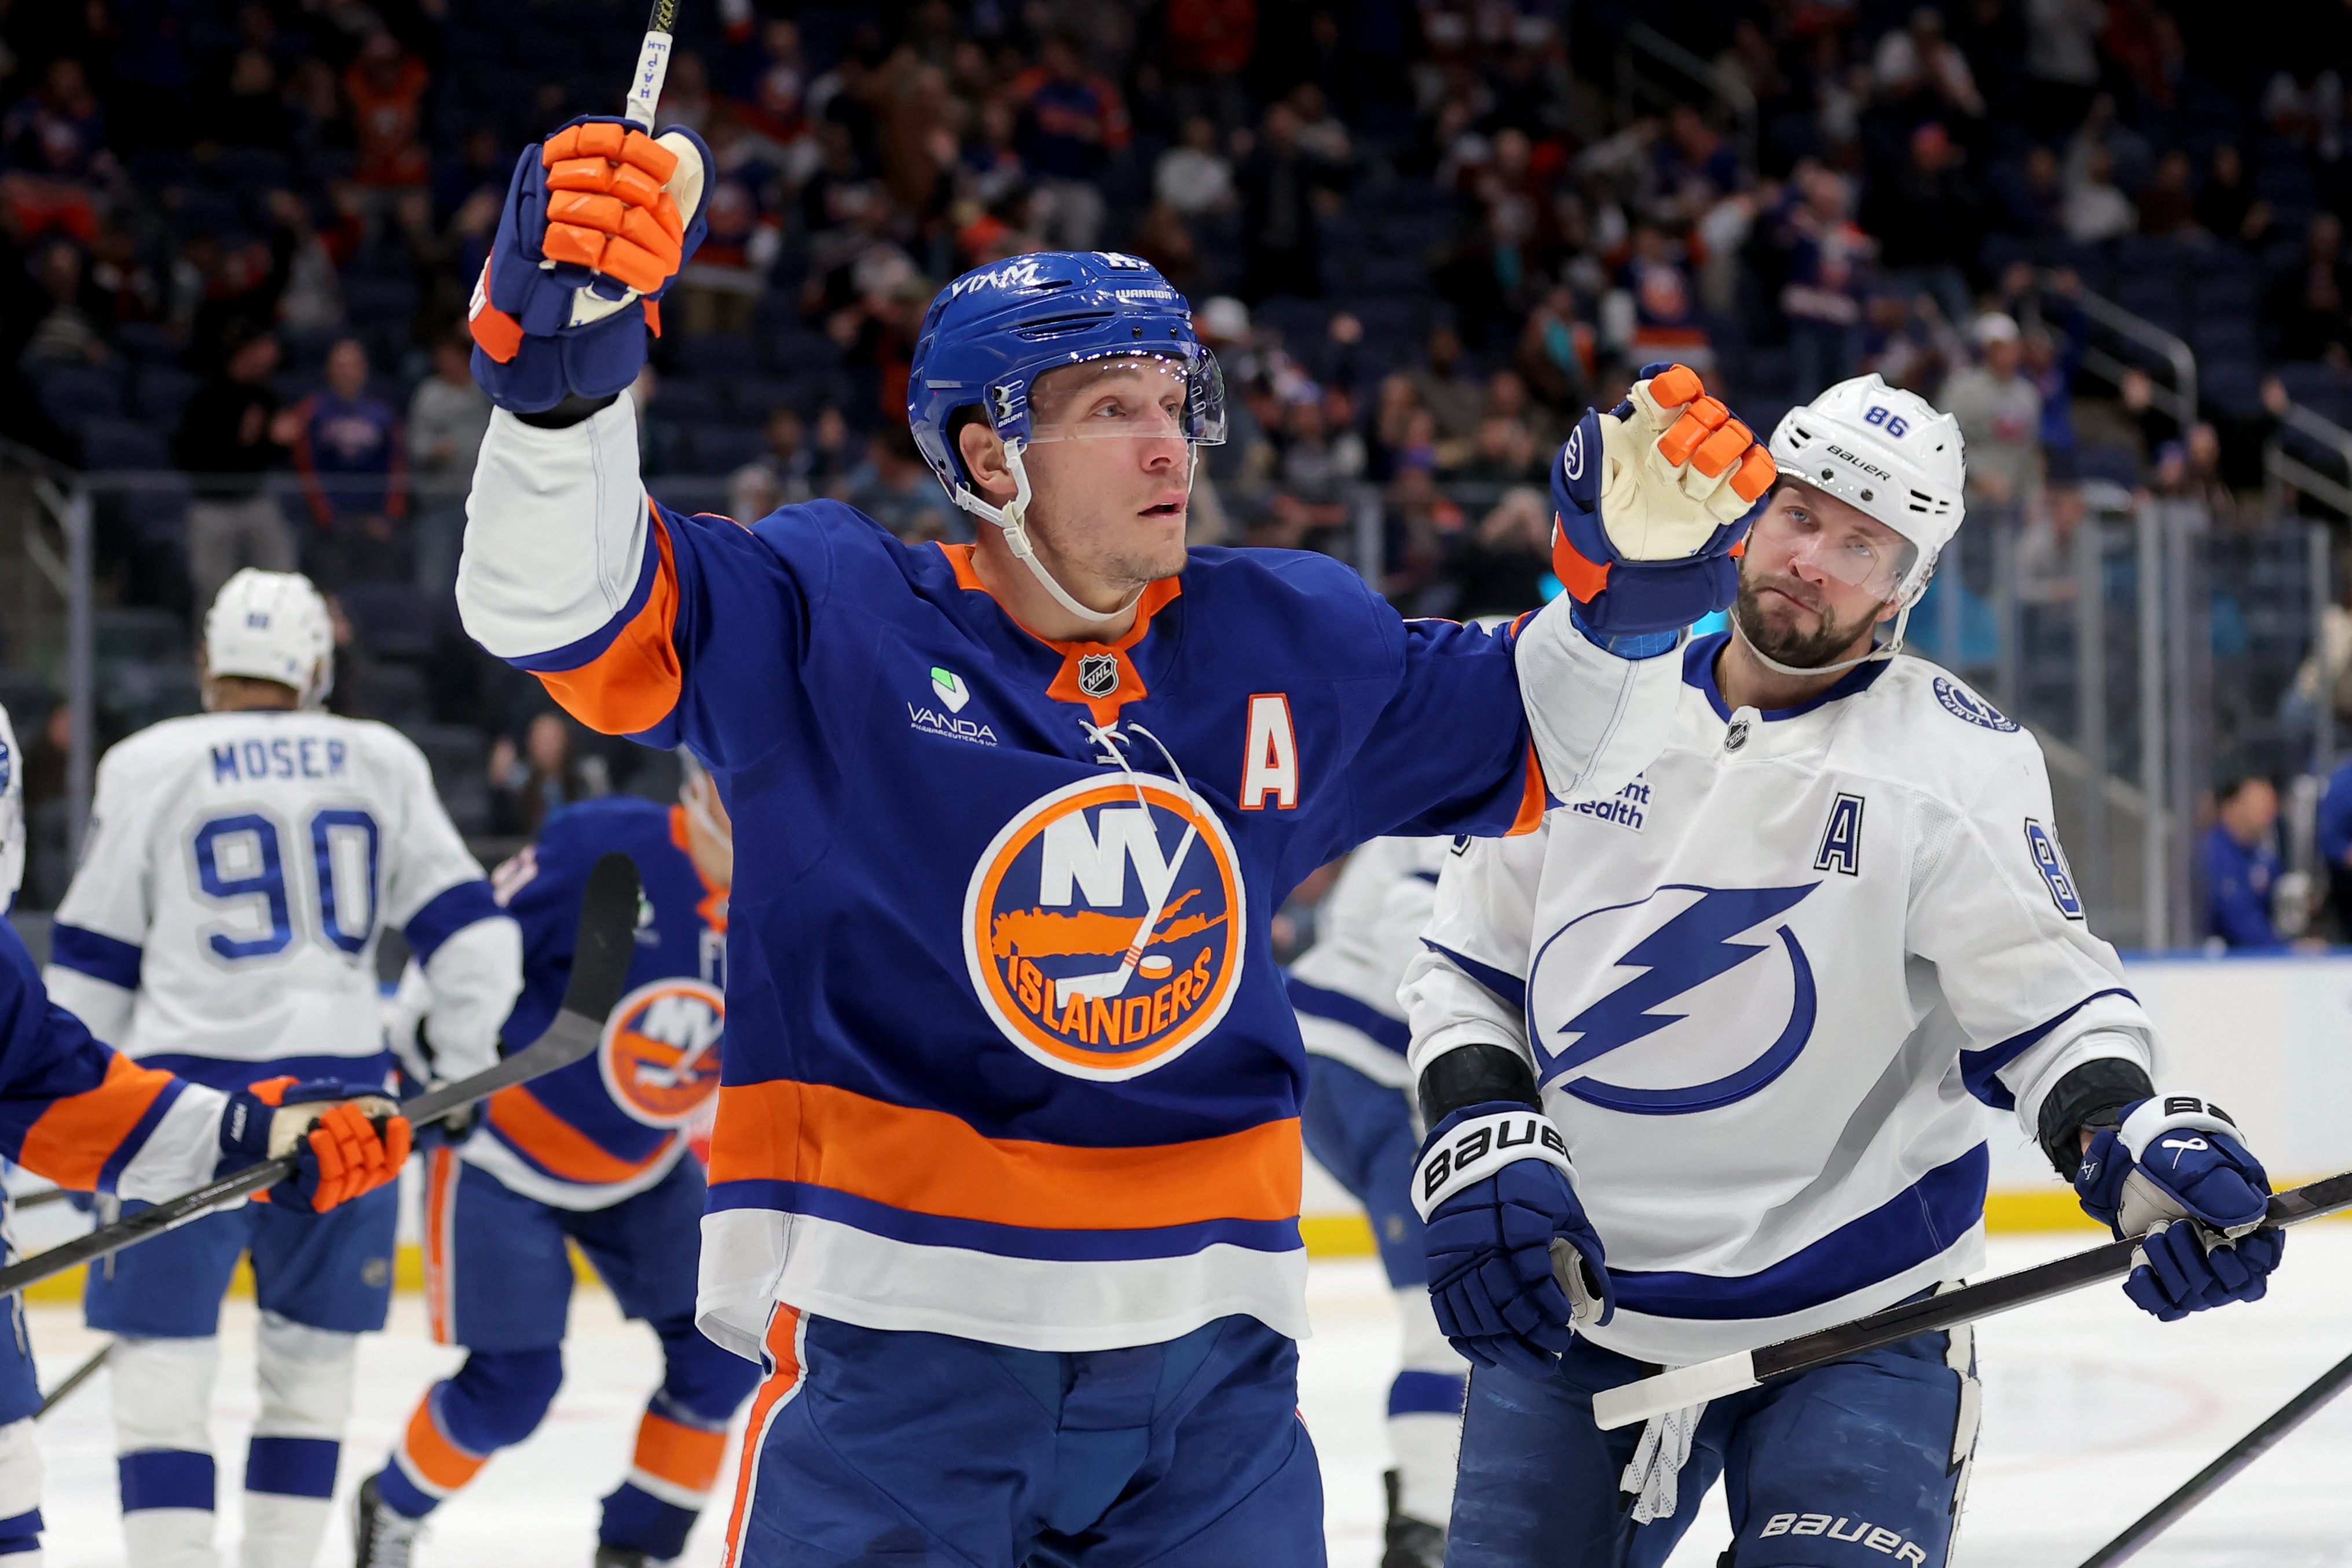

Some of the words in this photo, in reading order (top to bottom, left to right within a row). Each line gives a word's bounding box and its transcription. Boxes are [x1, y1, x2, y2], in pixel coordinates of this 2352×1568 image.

[1115, 290, 1172, 300] WARRIOR
[1864, 406, 1910, 439] 86
[1088, 665, 1111, 688] NHL
[907, 701, 997, 742] VANDA
[1728, 728, 1746, 747] NHL
[1940, 694, 1983, 725] TAMPA
[208, 737, 346, 785] MOSER
[1240, 693, 1298, 810] A
[1039, 807, 1198, 910] NY
[1814, 793, 1864, 876] A
[192, 806, 380, 960] 90
[2024, 817, 2084, 919] 8
[1008, 946, 1211, 1046] ISLANDERS
[1424, 1119, 1573, 1201] BAUE
